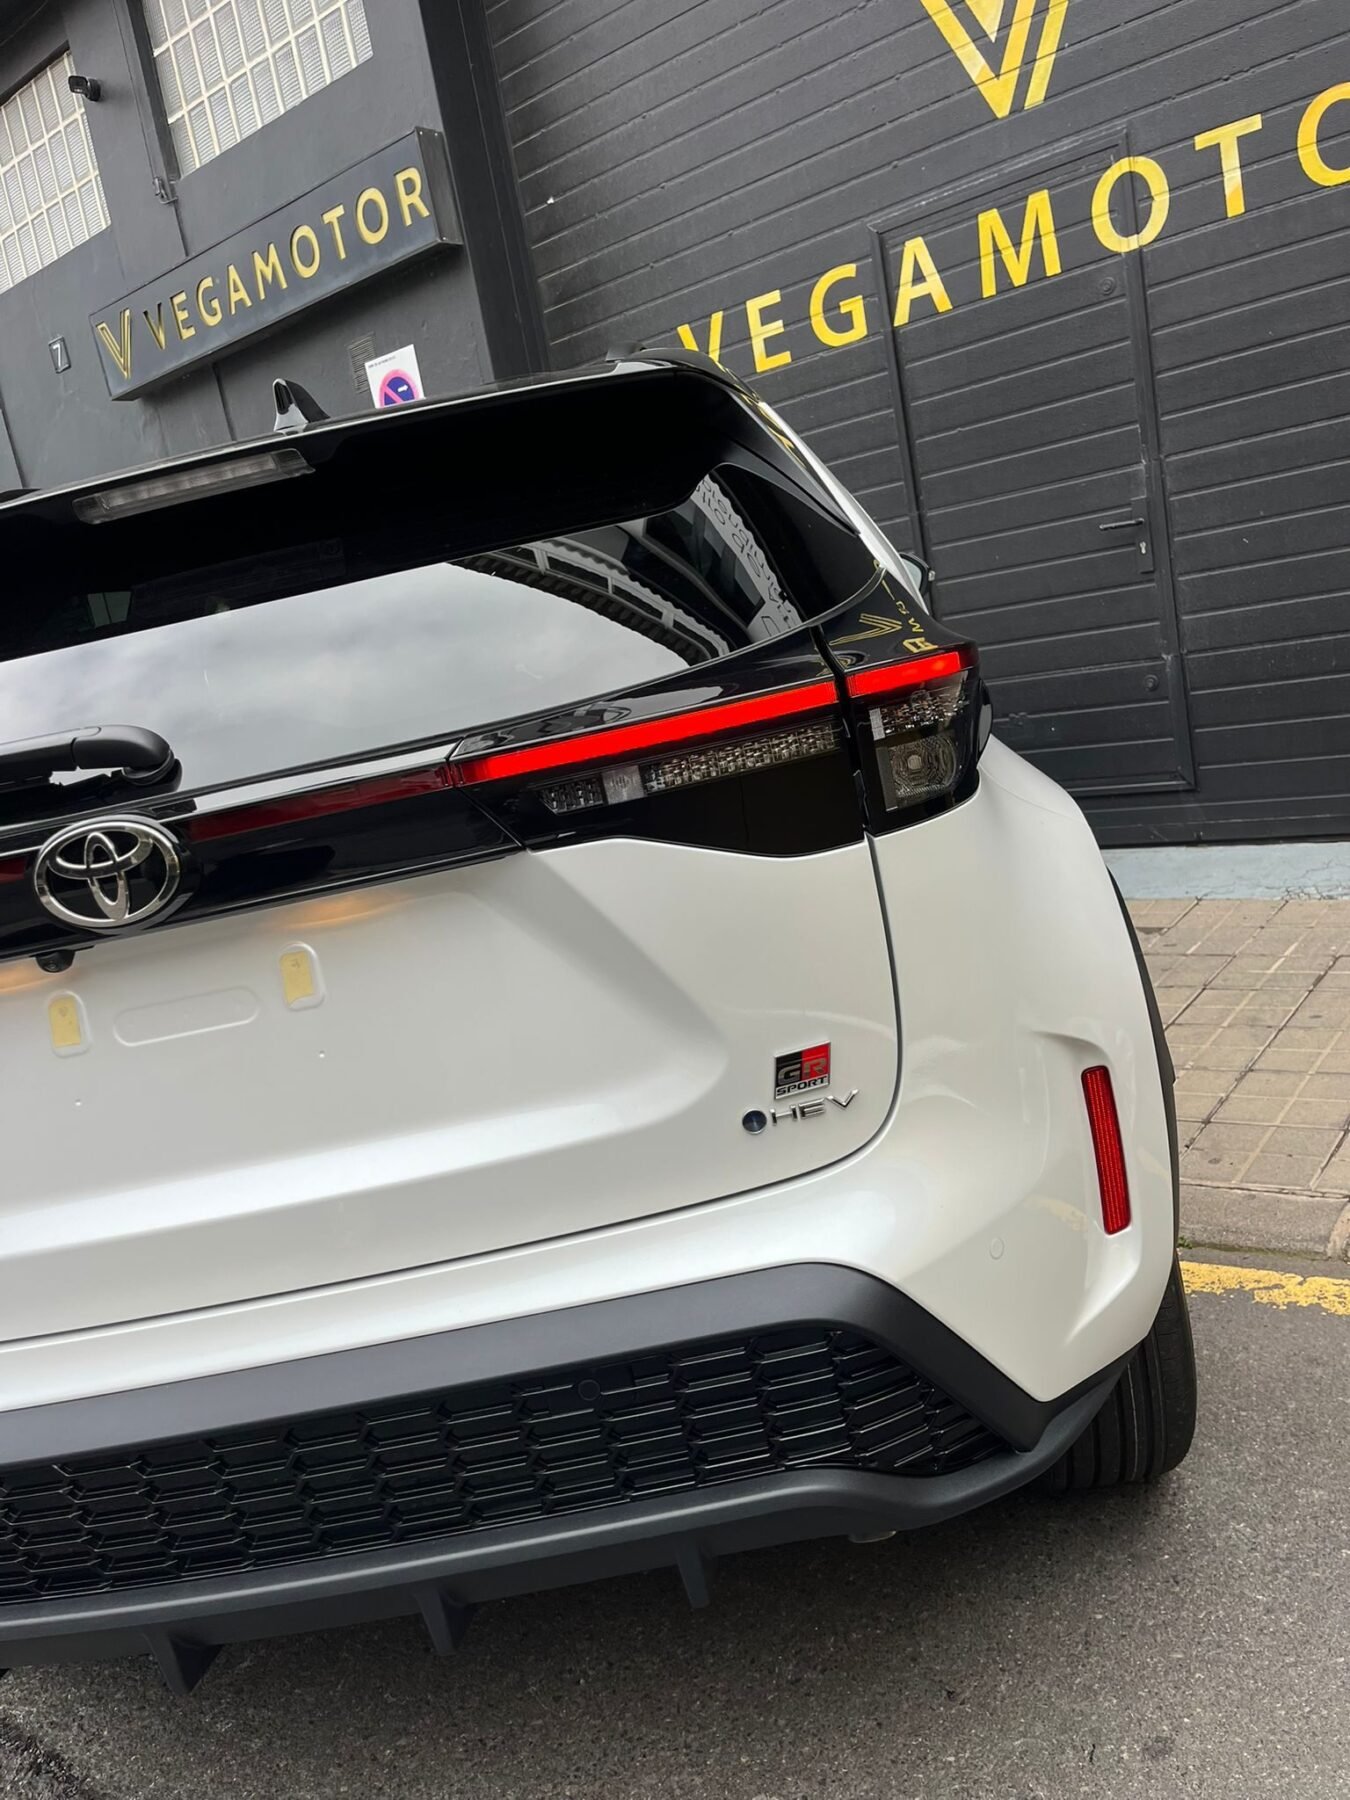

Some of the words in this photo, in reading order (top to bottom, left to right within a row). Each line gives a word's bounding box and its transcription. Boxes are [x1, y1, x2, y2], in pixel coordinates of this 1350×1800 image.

[143, 166, 430, 350] VEGAMOTOR
[776, 1075, 828, 1097] SPORT
[777, 1057, 827, 1085] GR
[769, 1088, 860, 1127] HEV
